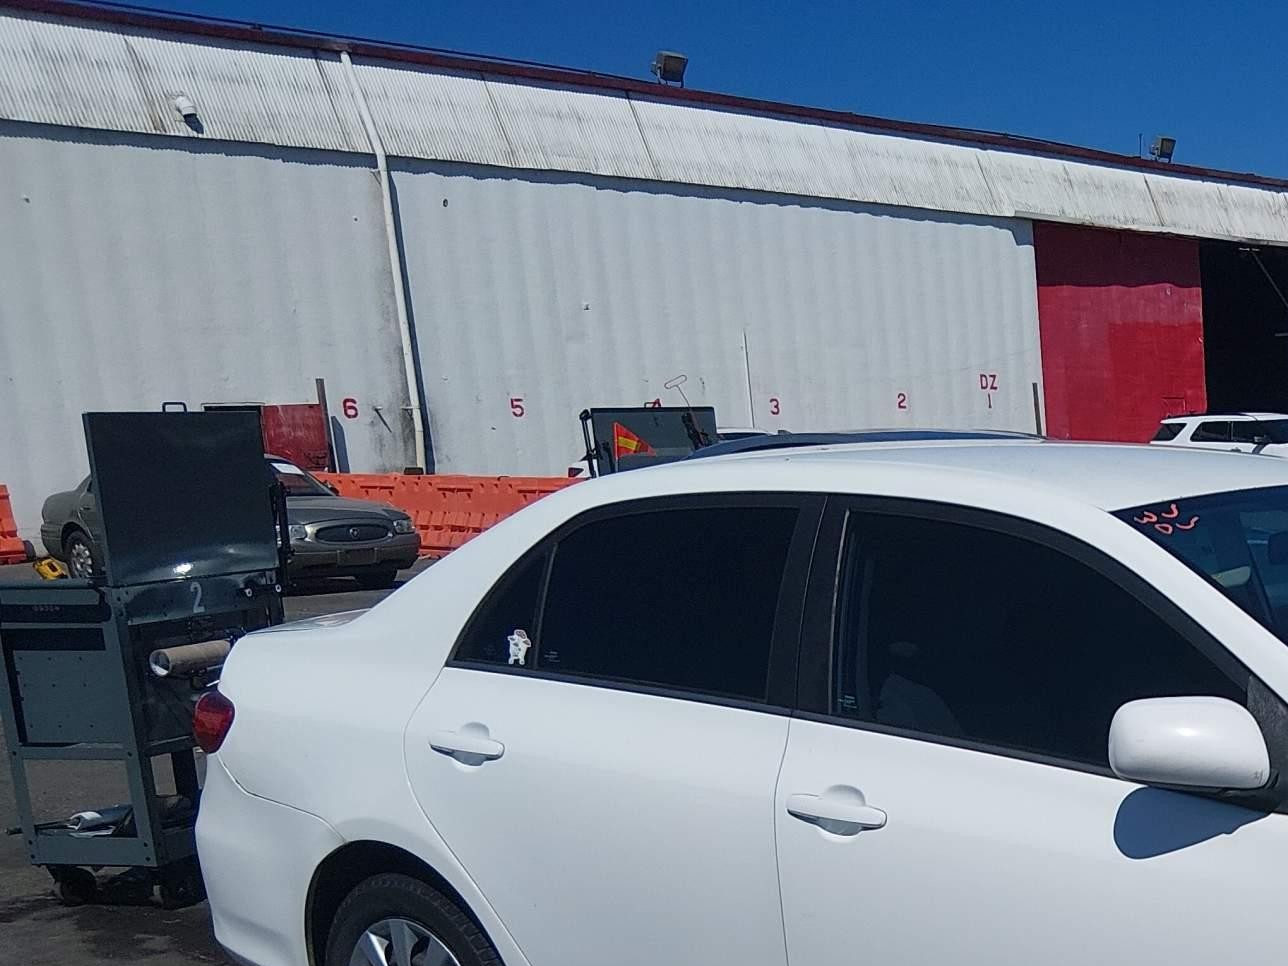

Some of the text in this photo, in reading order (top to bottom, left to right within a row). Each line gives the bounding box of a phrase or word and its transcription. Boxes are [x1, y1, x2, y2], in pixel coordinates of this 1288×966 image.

[980, 374, 998, 390] DZ
[342, 398, 358, 419] 6
[510, 398, 524, 417] 5
[769, 398, 780, 415] 3
[897, 393, 907, 409] 2
[190, 581, 206, 613] 2
